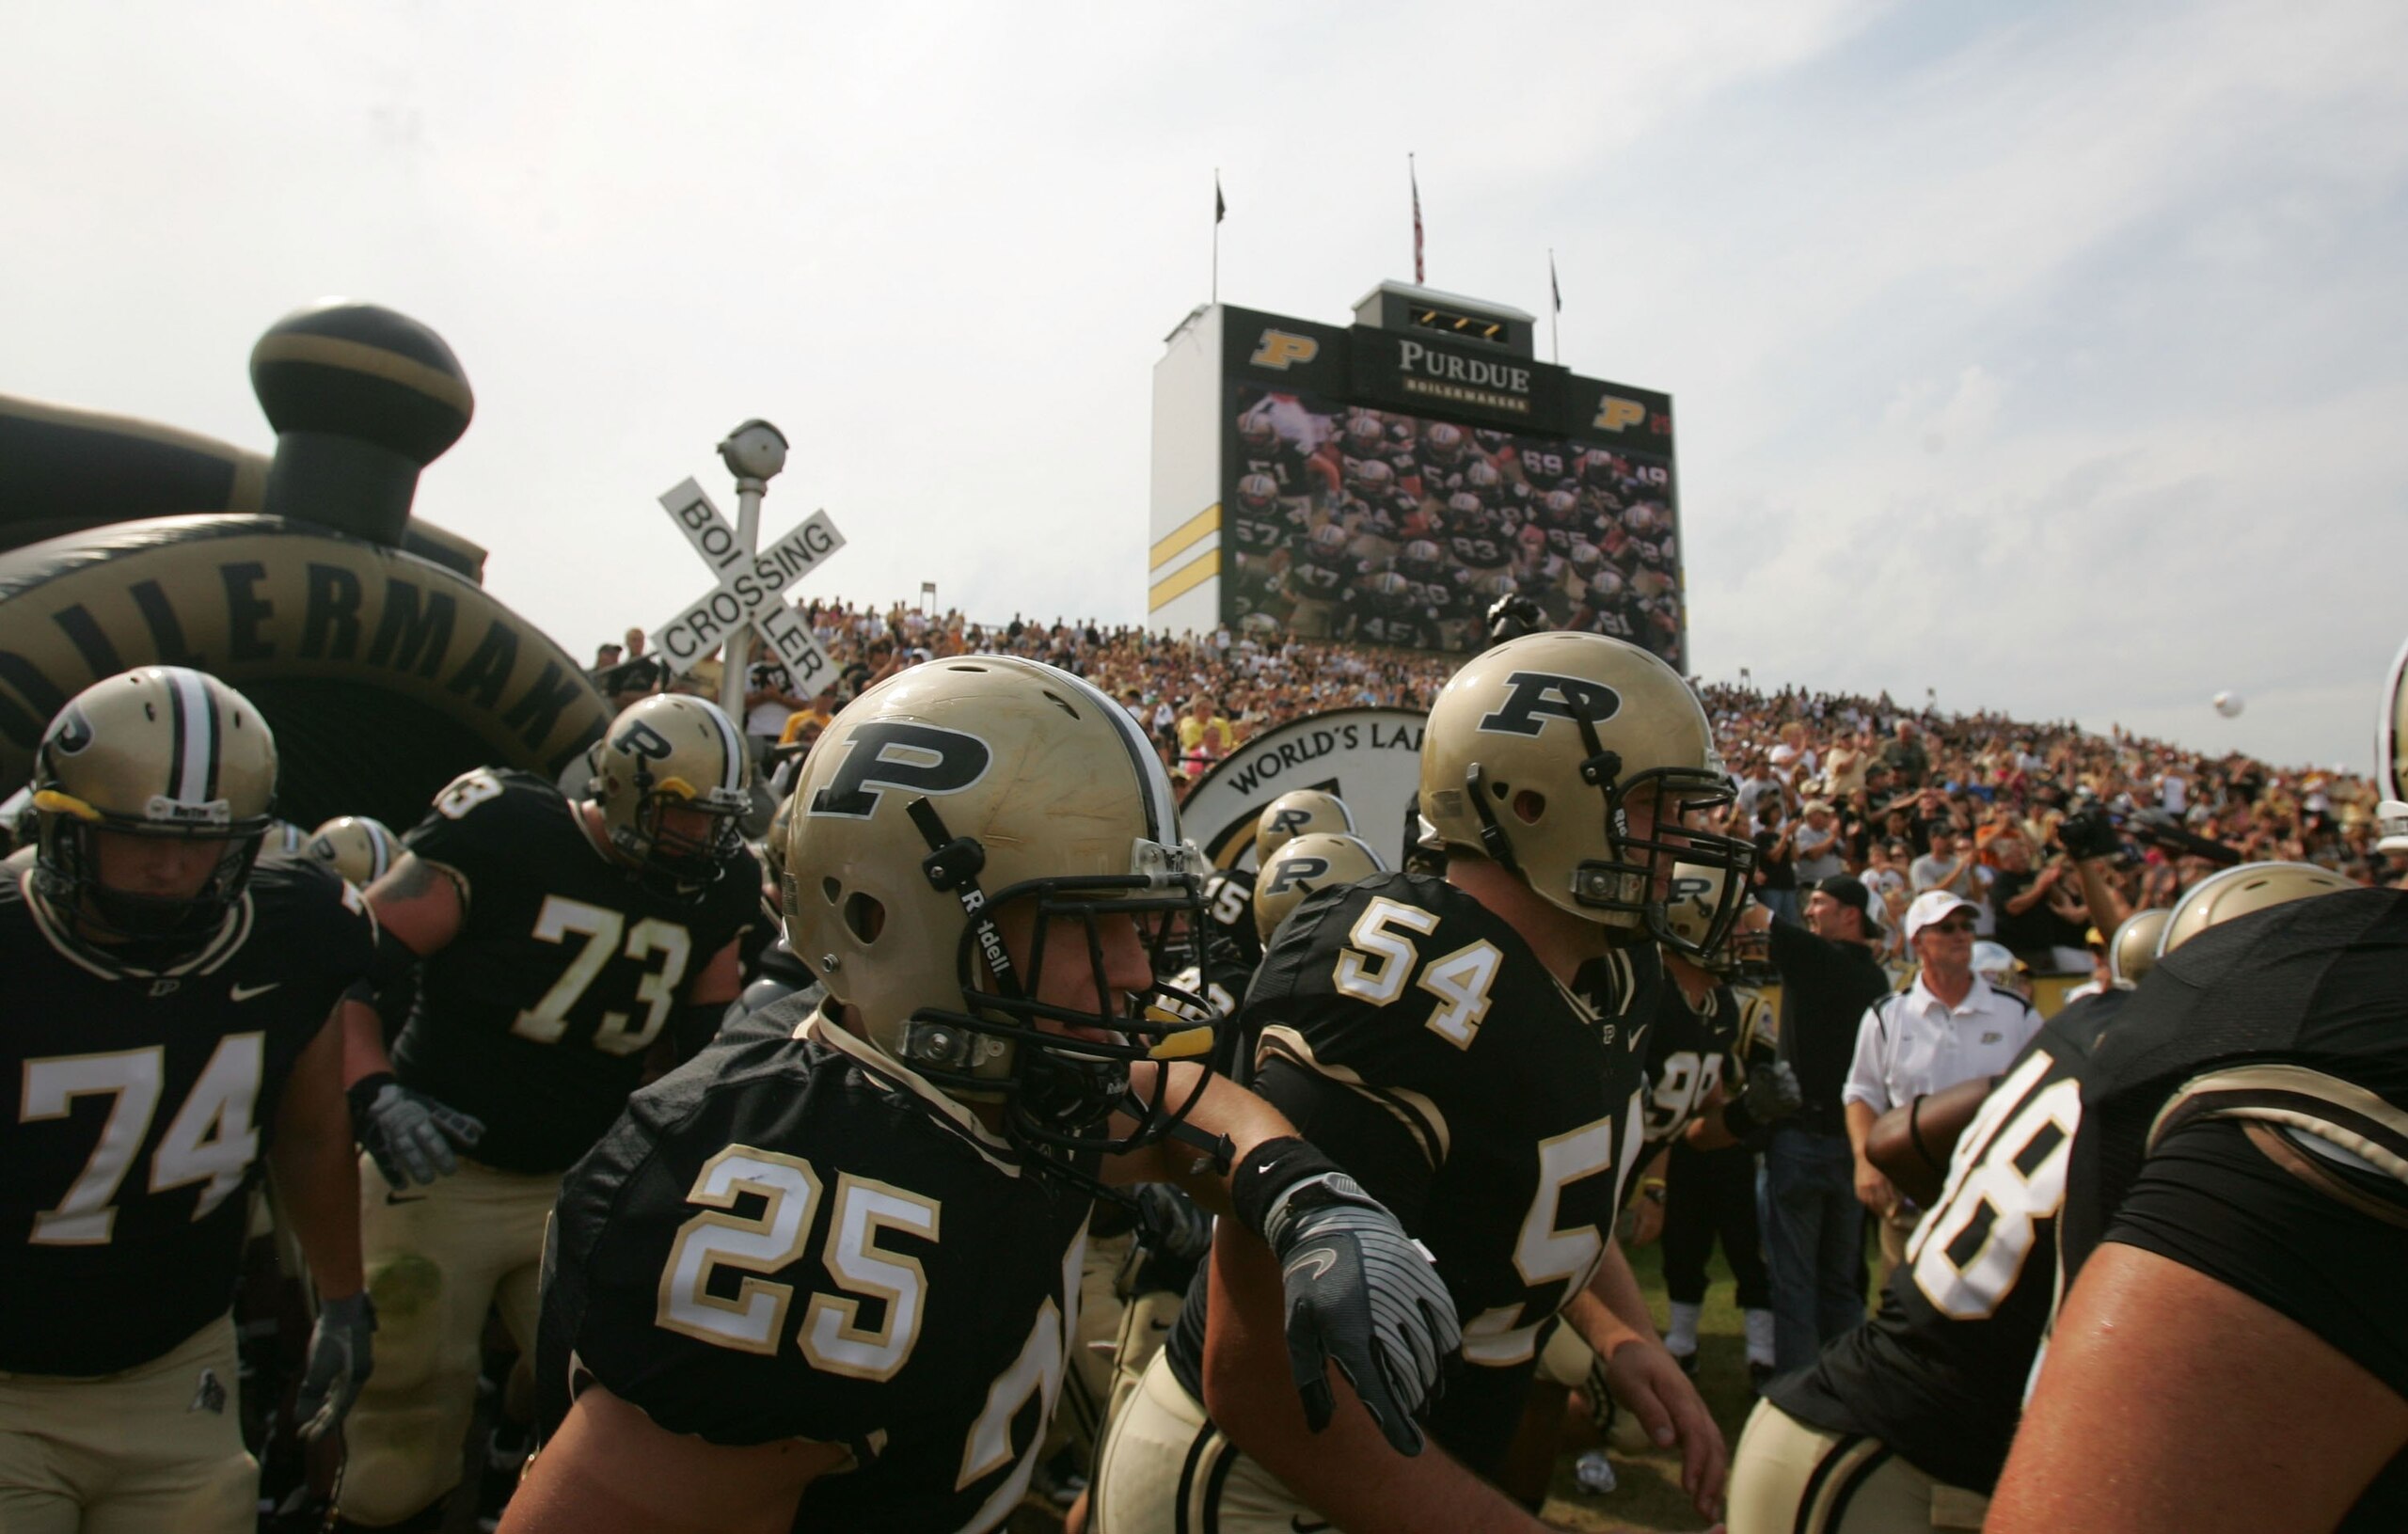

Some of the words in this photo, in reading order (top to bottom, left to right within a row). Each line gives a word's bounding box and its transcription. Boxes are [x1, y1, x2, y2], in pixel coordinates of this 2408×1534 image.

[1249, 327, 1319, 372] P
[1398, 339, 1530, 394] PURDUE
[1592, 394, 1646, 433] P
[664, 522, 835, 660] CROSSING
[1477, 670, 1623, 738] P
[806, 721, 992, 820] P
[1228, 724, 1359, 797] WORLD'S
[1263, 856, 1331, 898] P
[512, 894, 690, 1056] 73
[1333, 895, 1504, 1052] 54
[19, 1030, 267, 1245] 74
[654, 1142, 942, 1384] 25
